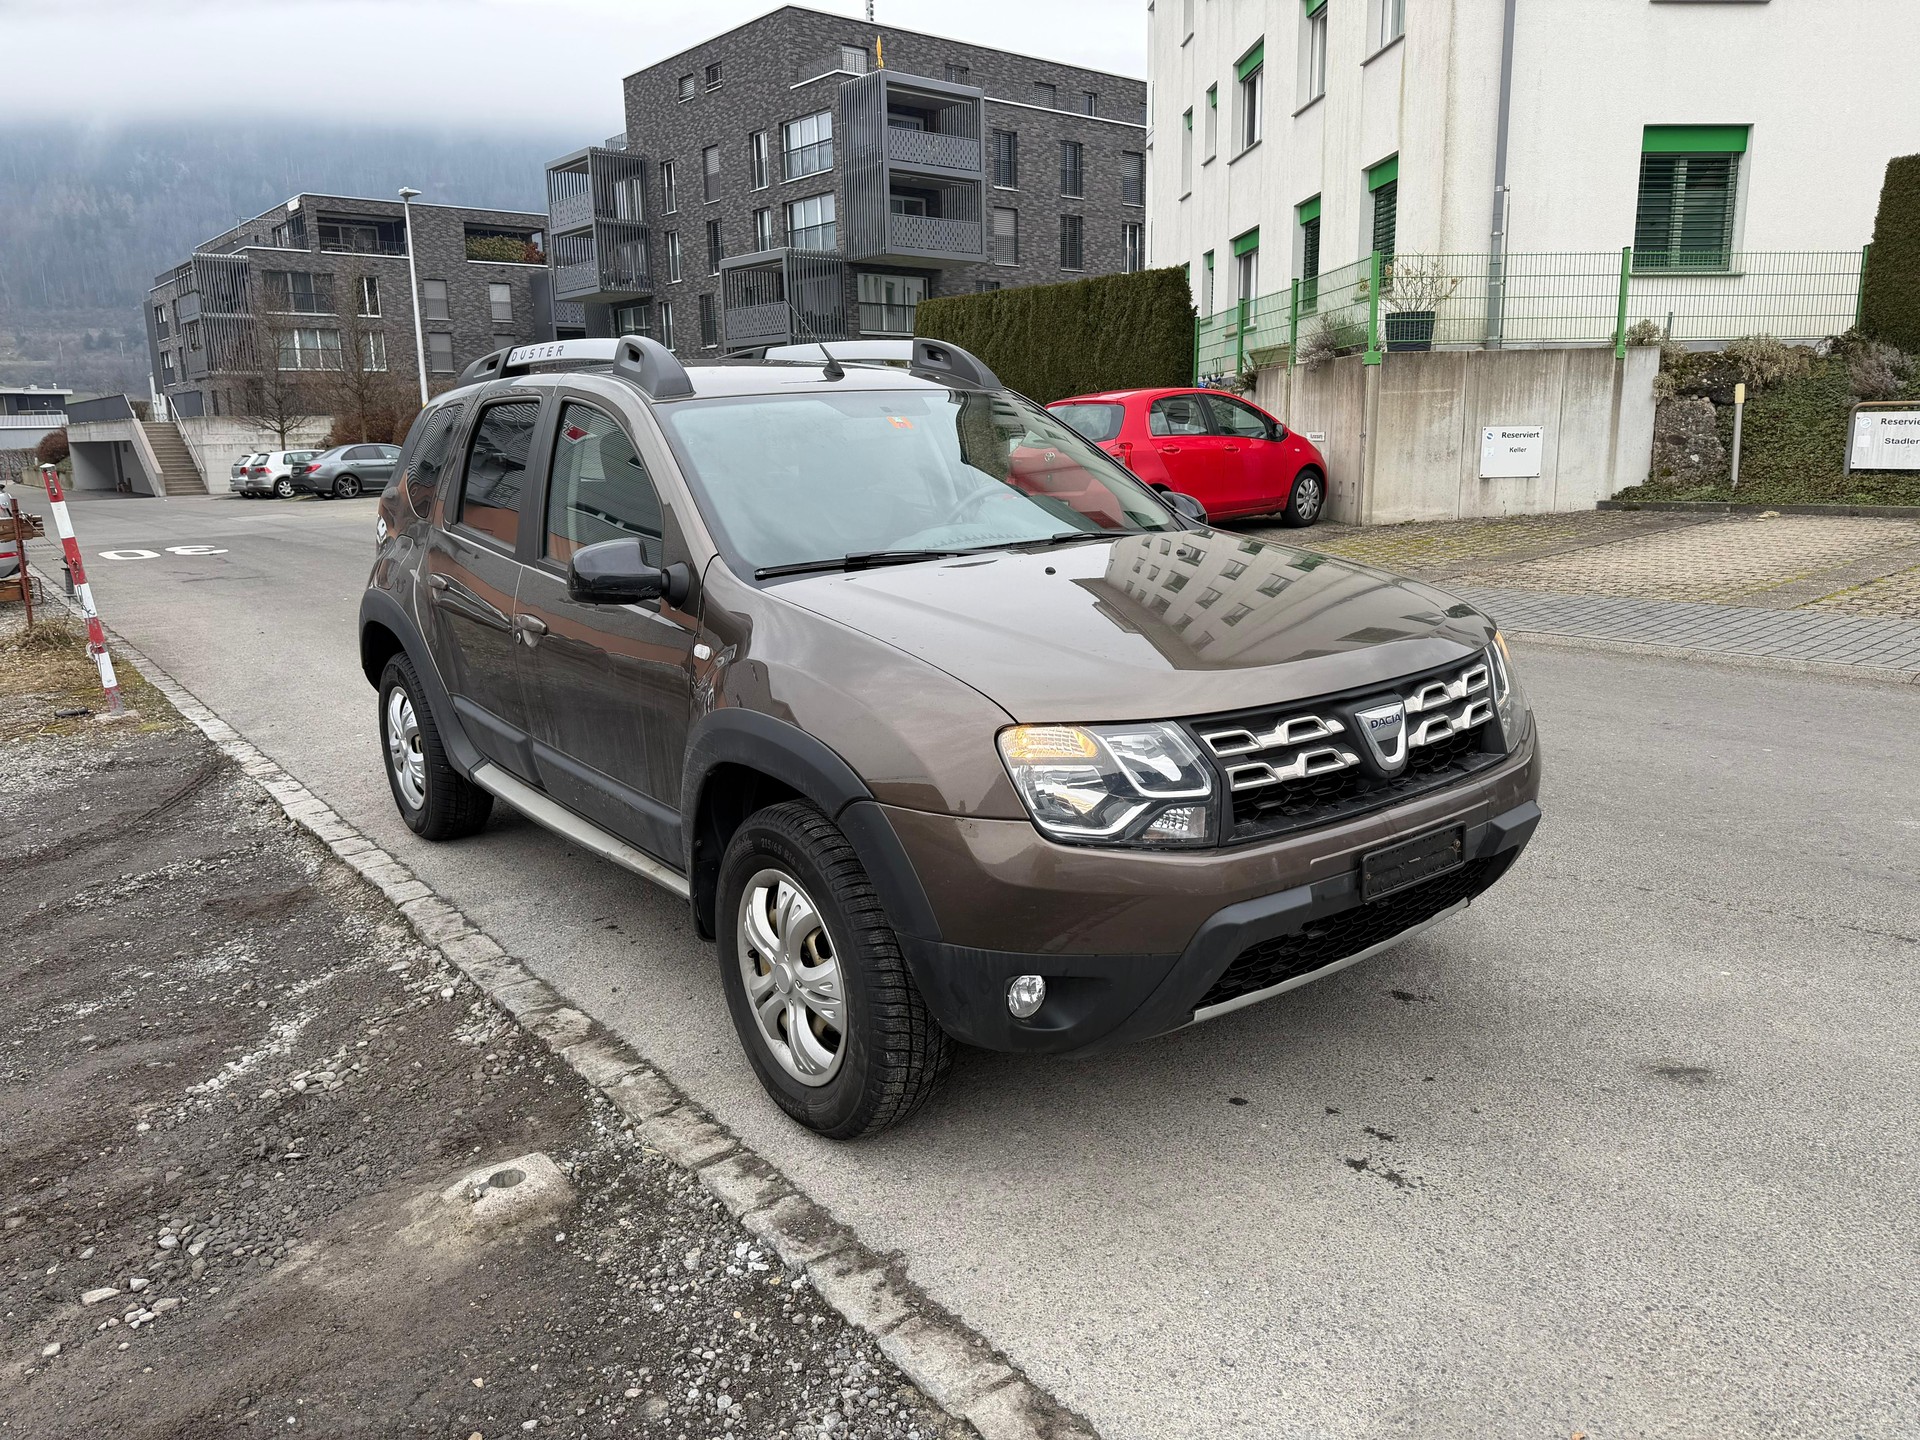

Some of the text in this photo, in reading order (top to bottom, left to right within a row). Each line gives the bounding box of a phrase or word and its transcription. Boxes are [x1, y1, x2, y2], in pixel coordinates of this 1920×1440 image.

[511, 345, 565, 362] DUSTER
[1501, 431, 1540, 439] Reserviert
[1370, 713, 1402, 730] DACIA
